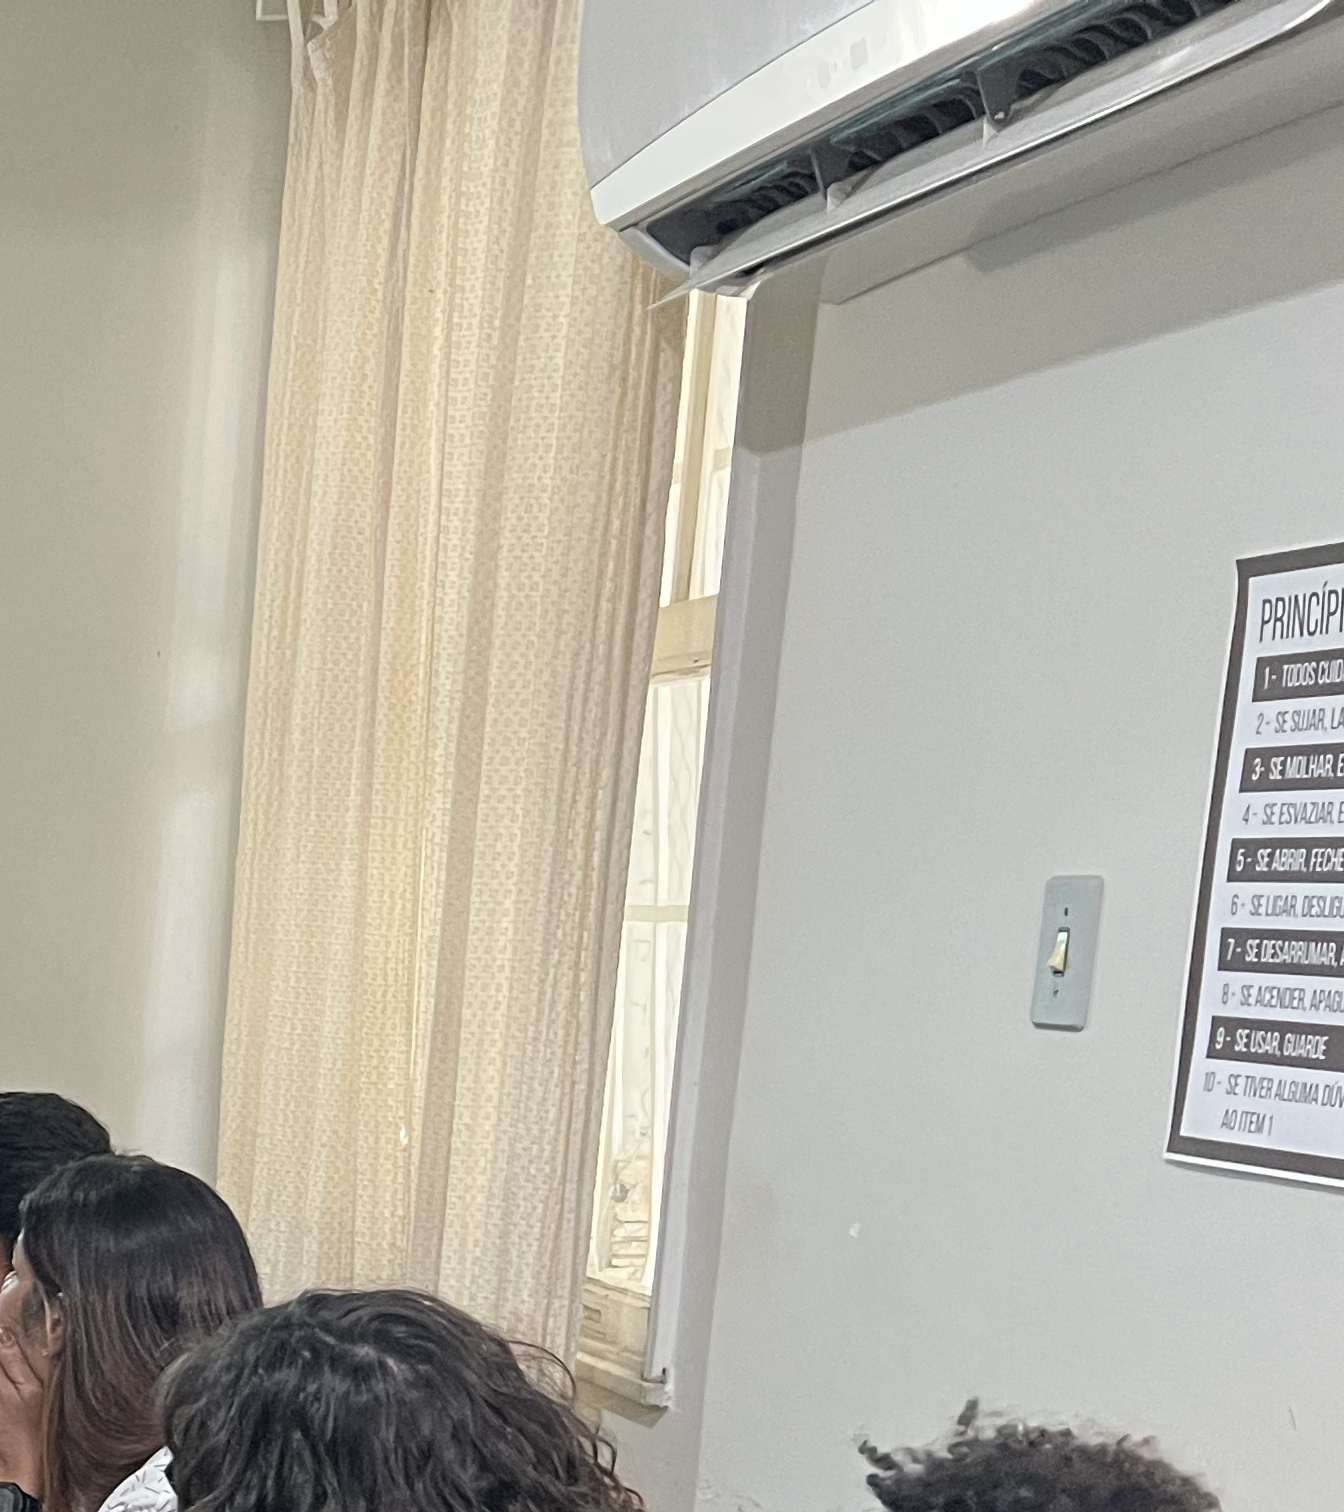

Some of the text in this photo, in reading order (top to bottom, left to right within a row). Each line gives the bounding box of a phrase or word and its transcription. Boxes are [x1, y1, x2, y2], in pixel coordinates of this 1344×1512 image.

[1264, 667, 1270, 690] 1
[1282, 661, 1317, 688] TODOS
[1318, 659, 1344, 685] CUID
[1256, 712, 1264, 735] 2
[1275, 710, 1289, 734] SE
[1290, 708, 1328, 733] SUJAR,
[1269, 756, 1285, 780] SE
[1284, 754, 1334, 780] MOLHAR,
[1242, 803, 1251, 825] 4
[1262, 802, 1277, 826] SE
[1278, 801, 1334, 825] ESVAZIAR,
[1236, 849, 1244, 872] 5
[1256, 848, 1272, 872] SE
[1272, 848, 1307, 872] ABRIR,
[1230, 894, 1239, 916] 6
[1250, 894, 1265, 916] SE
[1265, 894, 1299, 918] LIGAR,
[1226, 938, 1235, 960] 7
[1245, 939, 1260, 962] SE
[1260, 940, 1338, 968] DESARRUMAR,
[1222, 983, 1230, 1005] 8
[1240, 984, 1254, 1006] SE
[1254, 986, 1307, 1011] ACENDER,
[1215, 1027, 1225, 1050] 9
[1234, 1028, 1250, 1052] SE
[1250, 1030, 1281, 1058] USAR,
[1283, 1032, 1330, 1060] GUARDE
[1203, 1071, 1216, 1092] 10
[1226, 1074, 1242, 1096] SE
[1242, 1075, 1274, 1100] TIVER
[1274, 1080, 1319, 1106] ALGUMA
[1220, 1108, 1274, 1136] AO ITEM 1
